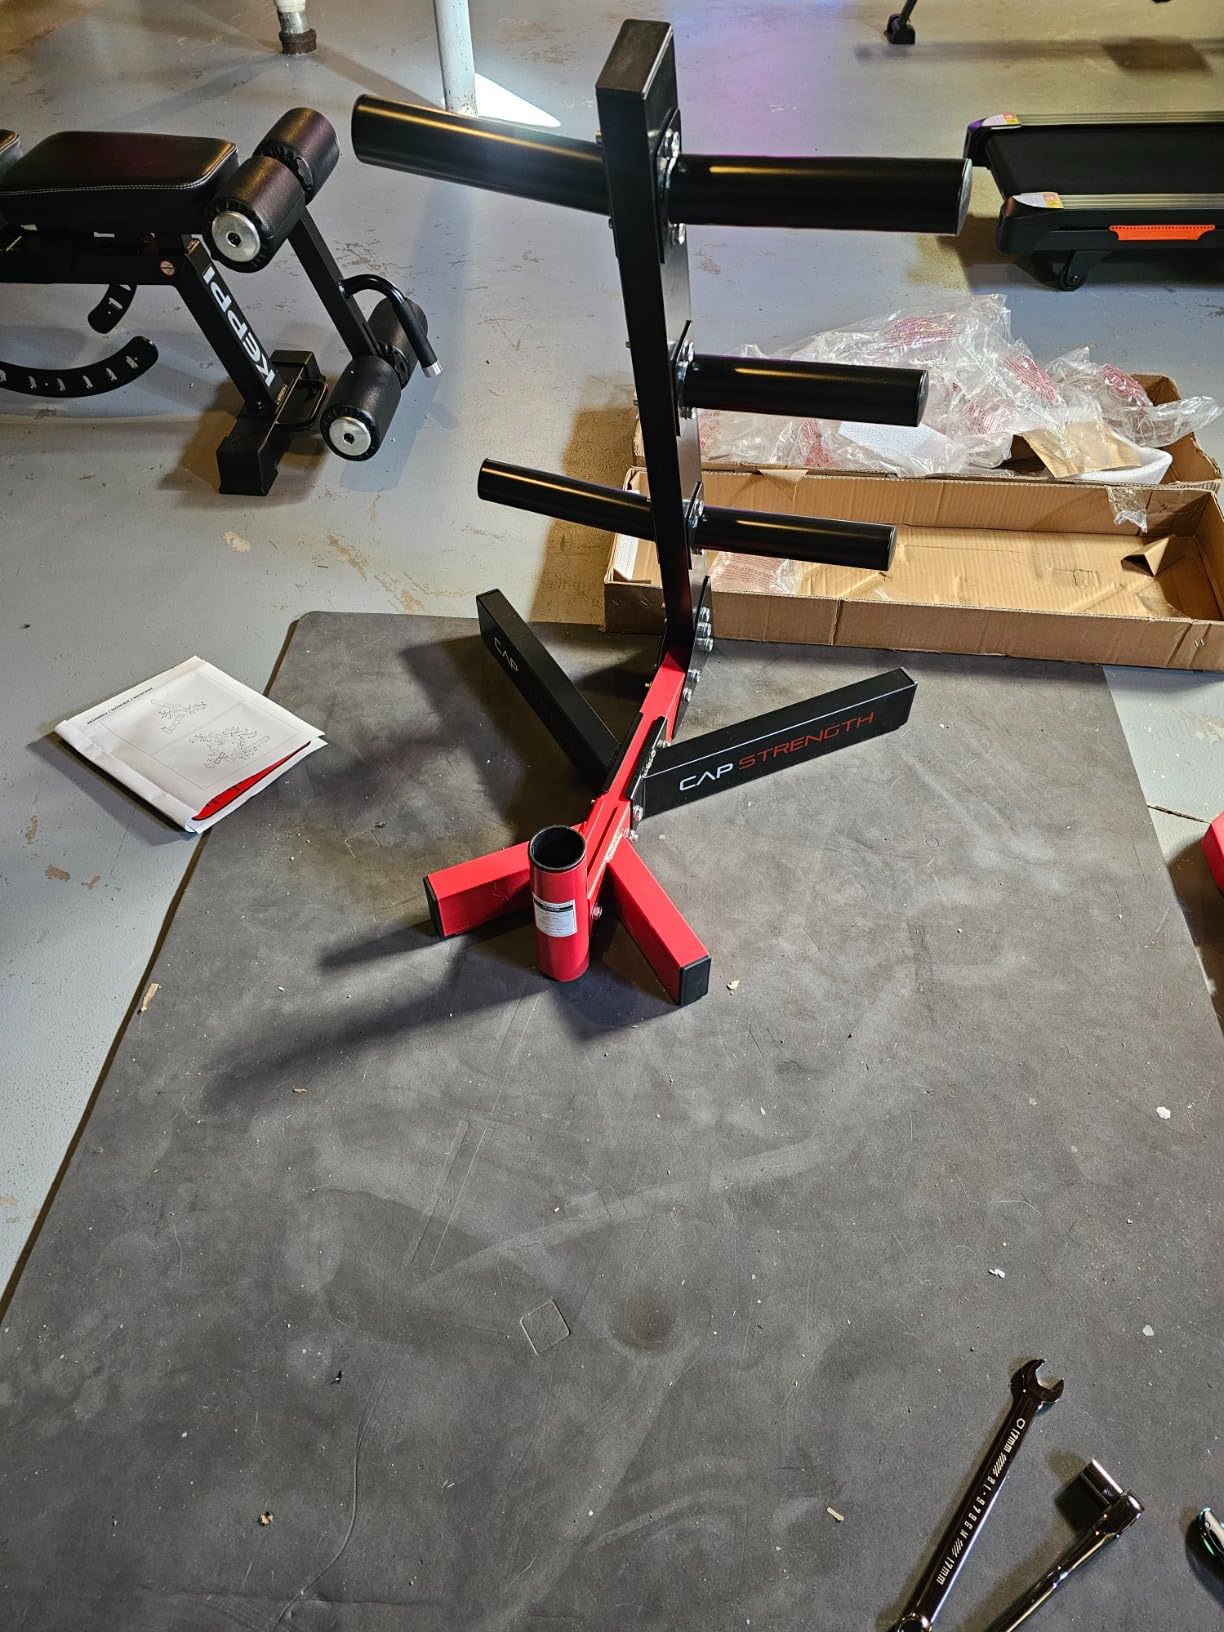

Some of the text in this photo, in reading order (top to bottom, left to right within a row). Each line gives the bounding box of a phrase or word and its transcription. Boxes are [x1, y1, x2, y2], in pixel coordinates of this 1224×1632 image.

[203, 266, 275, 387] KEPPI
[494, 637, 518, 672] CAP
[679, 711, 875, 791] CAP STRENGTH
[1003, 1428, 1021, 1454] 17mm
[936, 1556, 955, 1586] 17mm
